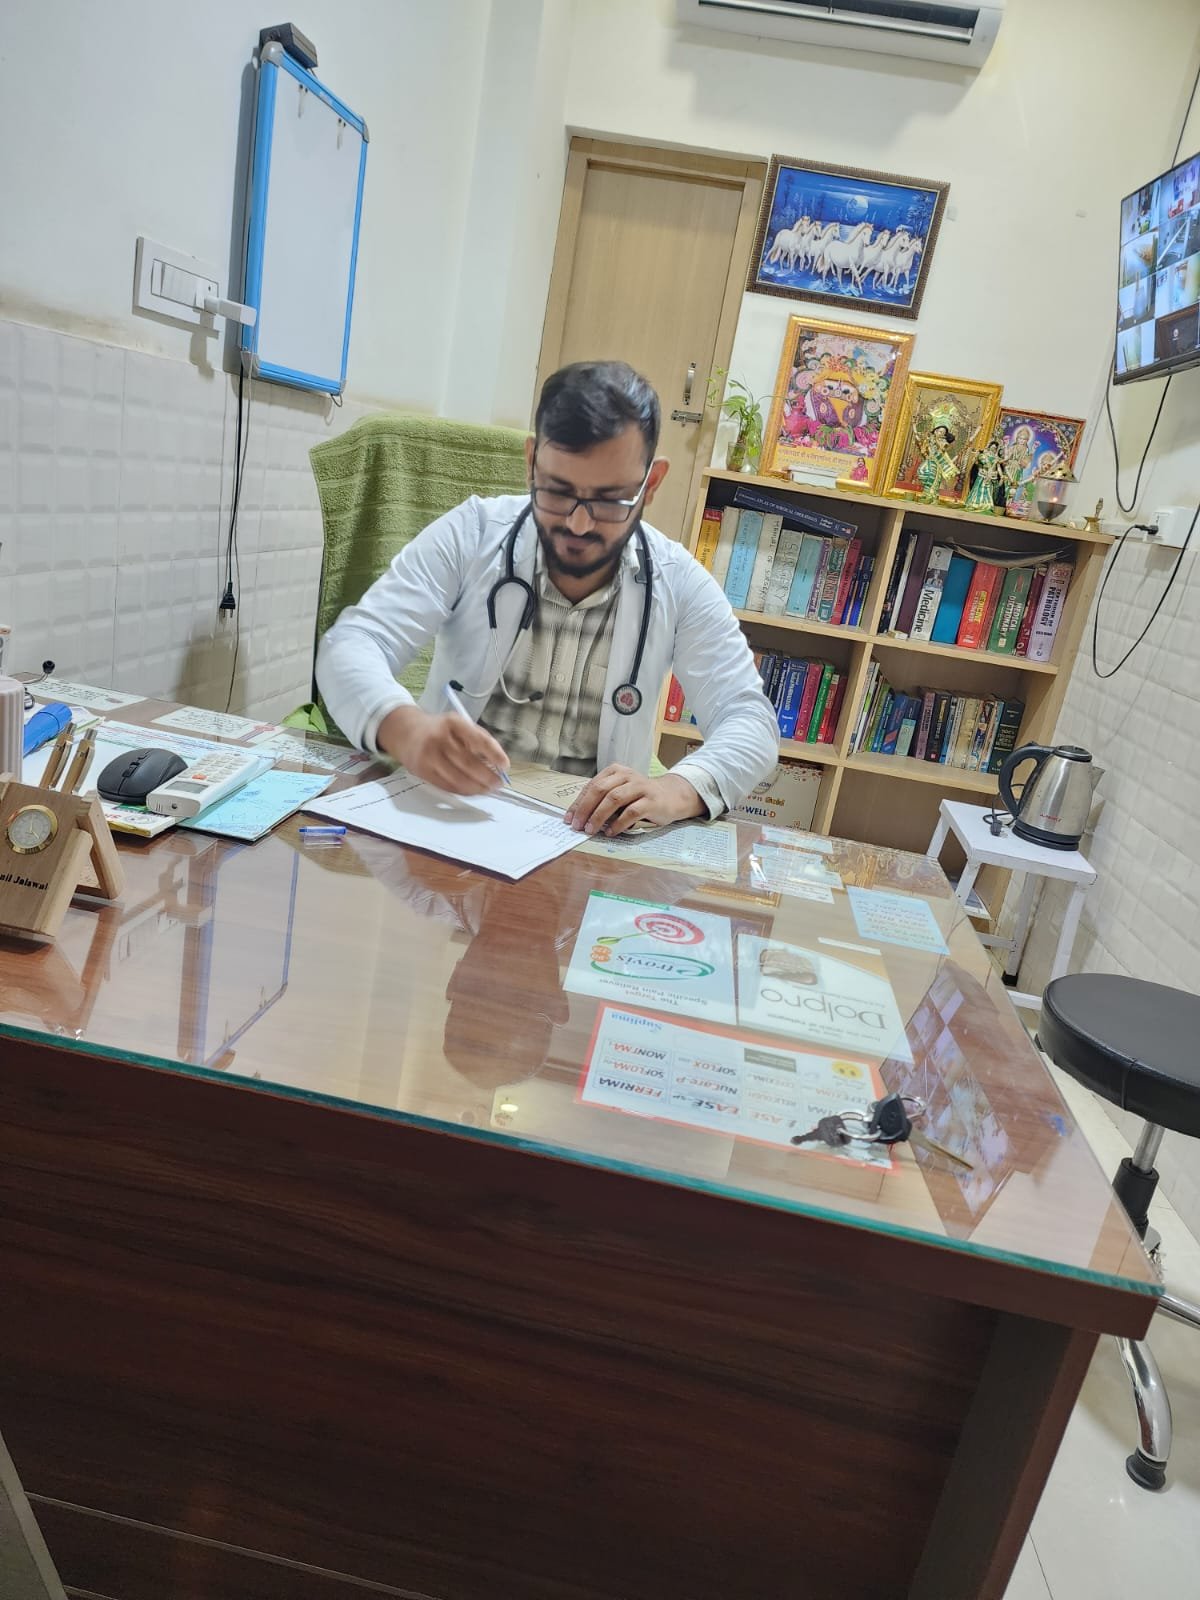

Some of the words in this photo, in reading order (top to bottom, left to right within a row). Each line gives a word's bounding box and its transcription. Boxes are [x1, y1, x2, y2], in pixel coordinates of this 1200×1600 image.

[775, 543, 798, 602] SURGERY
[914, 589, 935, 633] Medicine
[999, 595, 1017, 637] DICTIONARY
[1008, 602, 1022, 631] MEDICAL
[1040, 586, 1056, 627] PATHOLOGY
[760, 988, 888, 1029] Dolpro
[599, 1076, 663, 1099] FERRIMA
[692, 1059, 737, 1077] SOFLOX
